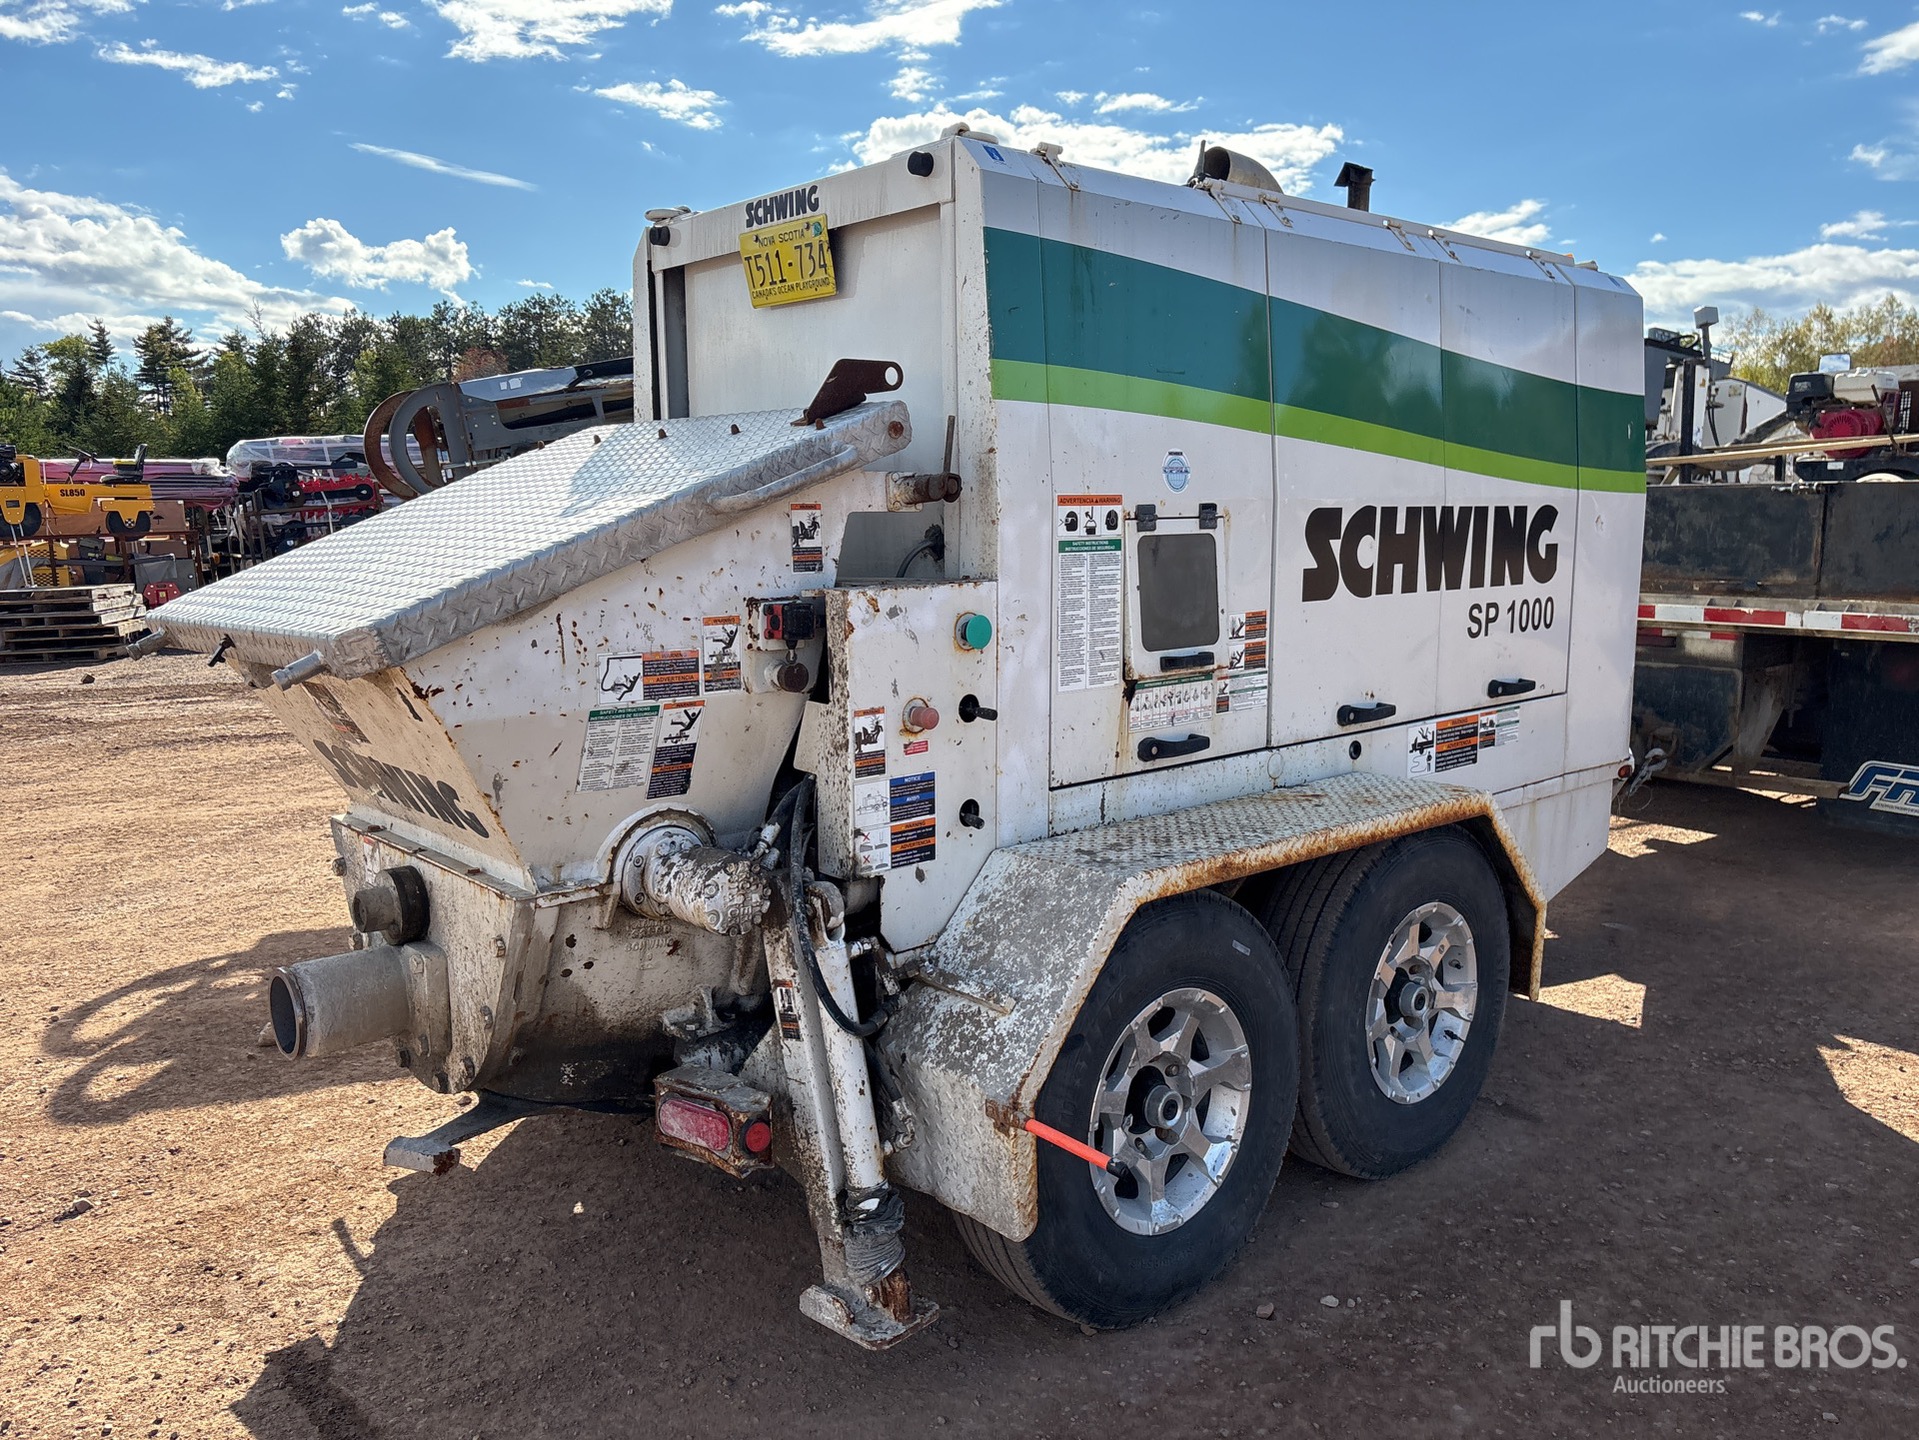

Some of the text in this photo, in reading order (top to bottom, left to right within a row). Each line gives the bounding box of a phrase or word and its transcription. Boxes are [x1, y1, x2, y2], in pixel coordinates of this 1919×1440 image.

[745, 185, 820, 228] SCHWING
[758, 228, 806, 249] NOVA SCOTIA
[751, 276, 831, 300] CANADA'S OCEAN PLAYGROUND
[59, 488, 86, 498] SL850
[1059, 496, 1122, 504] ADVERTENCIA WARNING
[1301, 503, 1560, 603] SCHWING
[1467, 596, 1555, 639] SP 1000
[655, 674, 695, 683] ADVERTENCIA
[1446, 739, 1472, 749] ADVERTENCIA
[904, 775, 922, 784] NOTICE
[904, 820, 927, 830] WARNING
[899, 838, 932, 850] ADVERTENCIA
